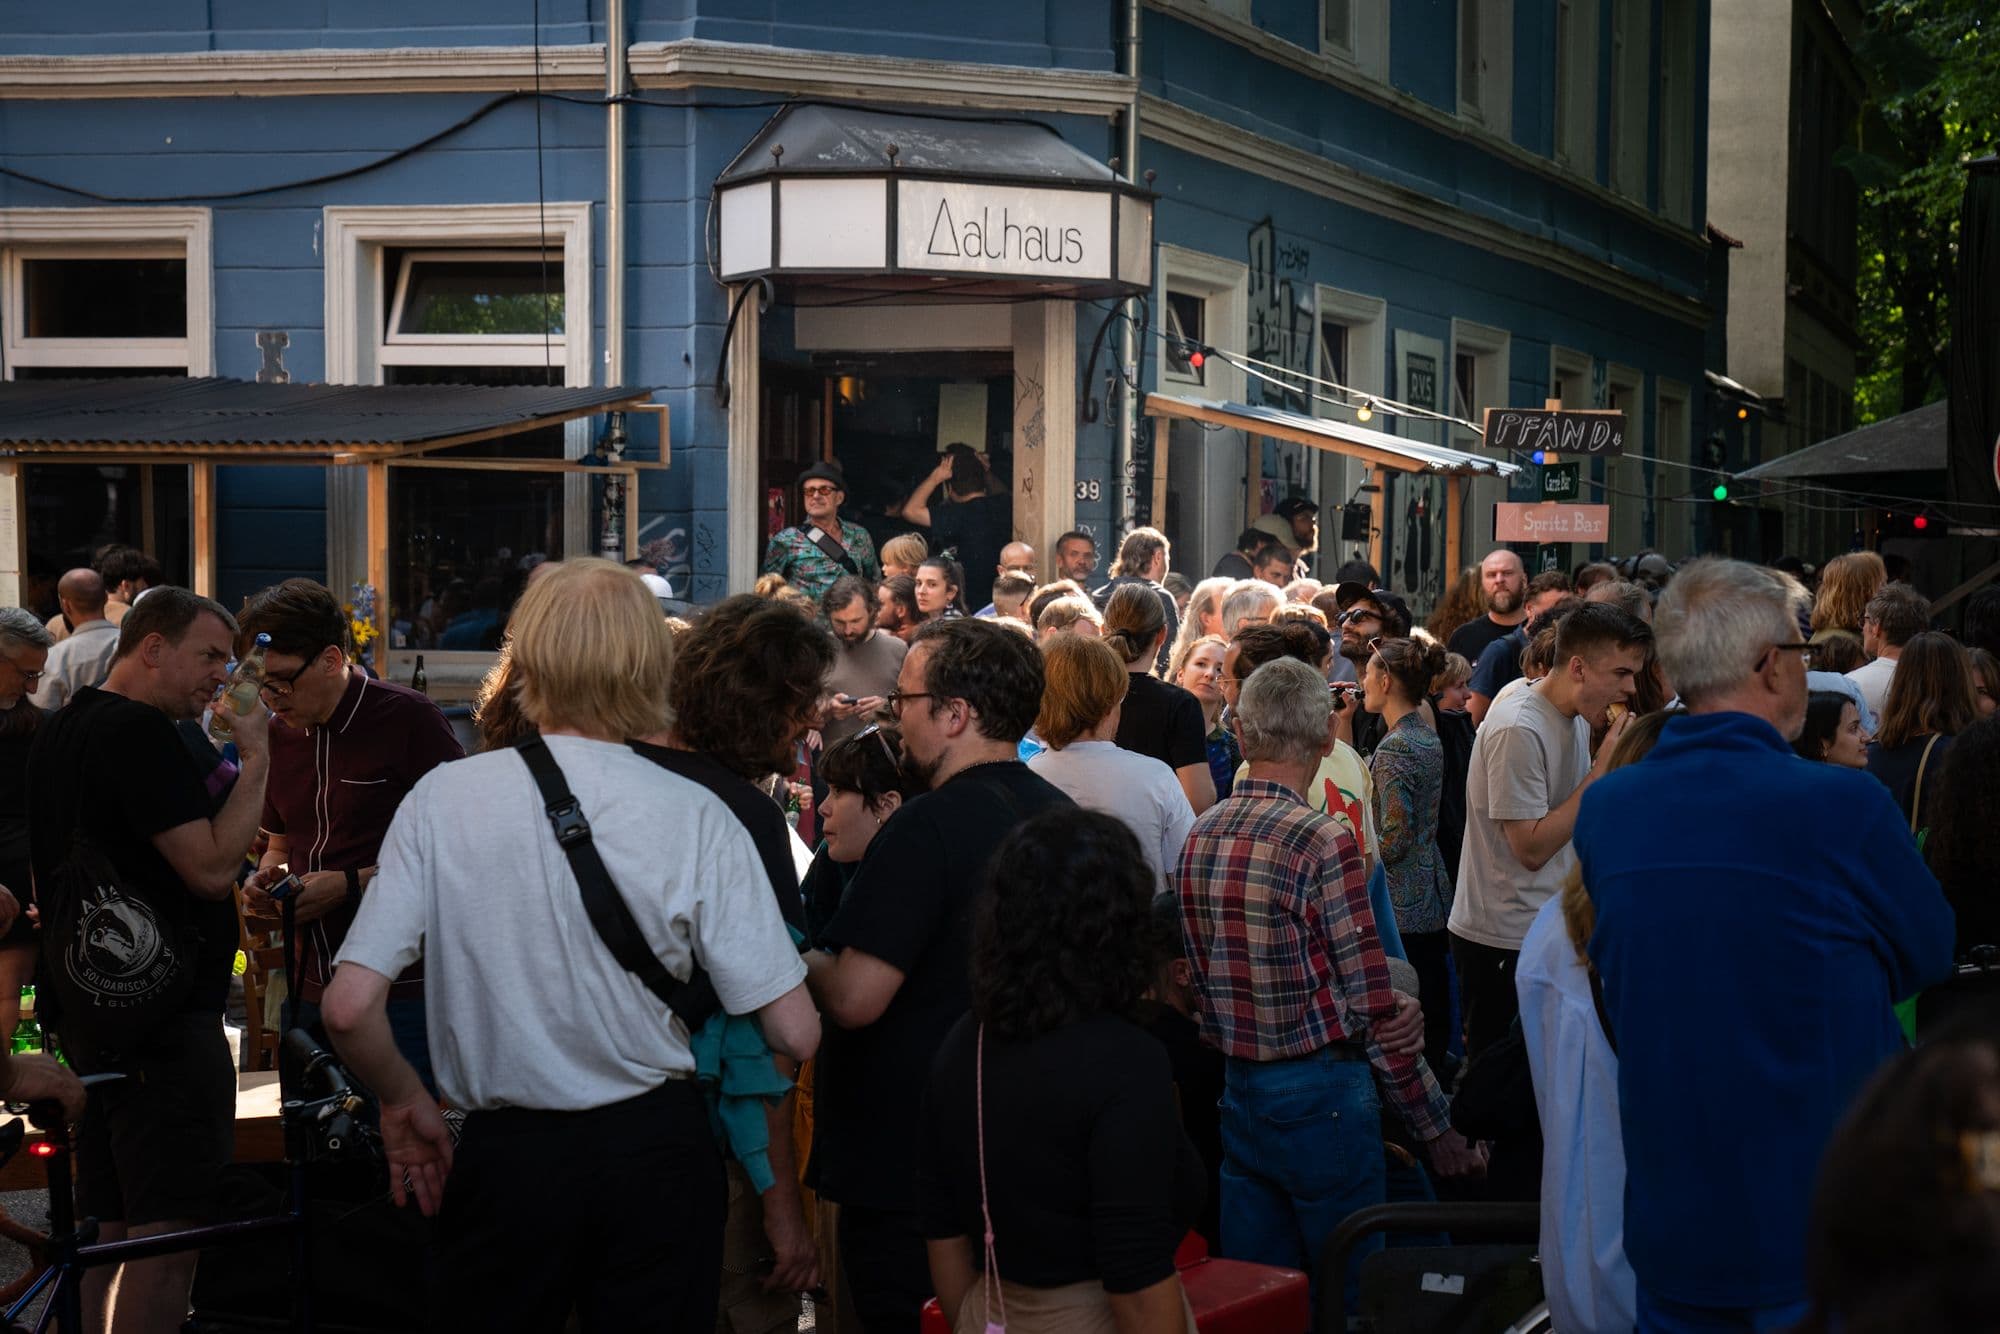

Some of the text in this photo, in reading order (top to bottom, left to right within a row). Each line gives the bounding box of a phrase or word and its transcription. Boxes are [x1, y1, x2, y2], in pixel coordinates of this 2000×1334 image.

[928, 198, 1083, 264] Aalhaus
[1494, 413, 1611, 452] PFAND
[1076, 480, 1100, 500] 39
[1523, 511, 1602, 539] Spritz Bar
[83, 967, 148, 993] SOLIDARISCH
